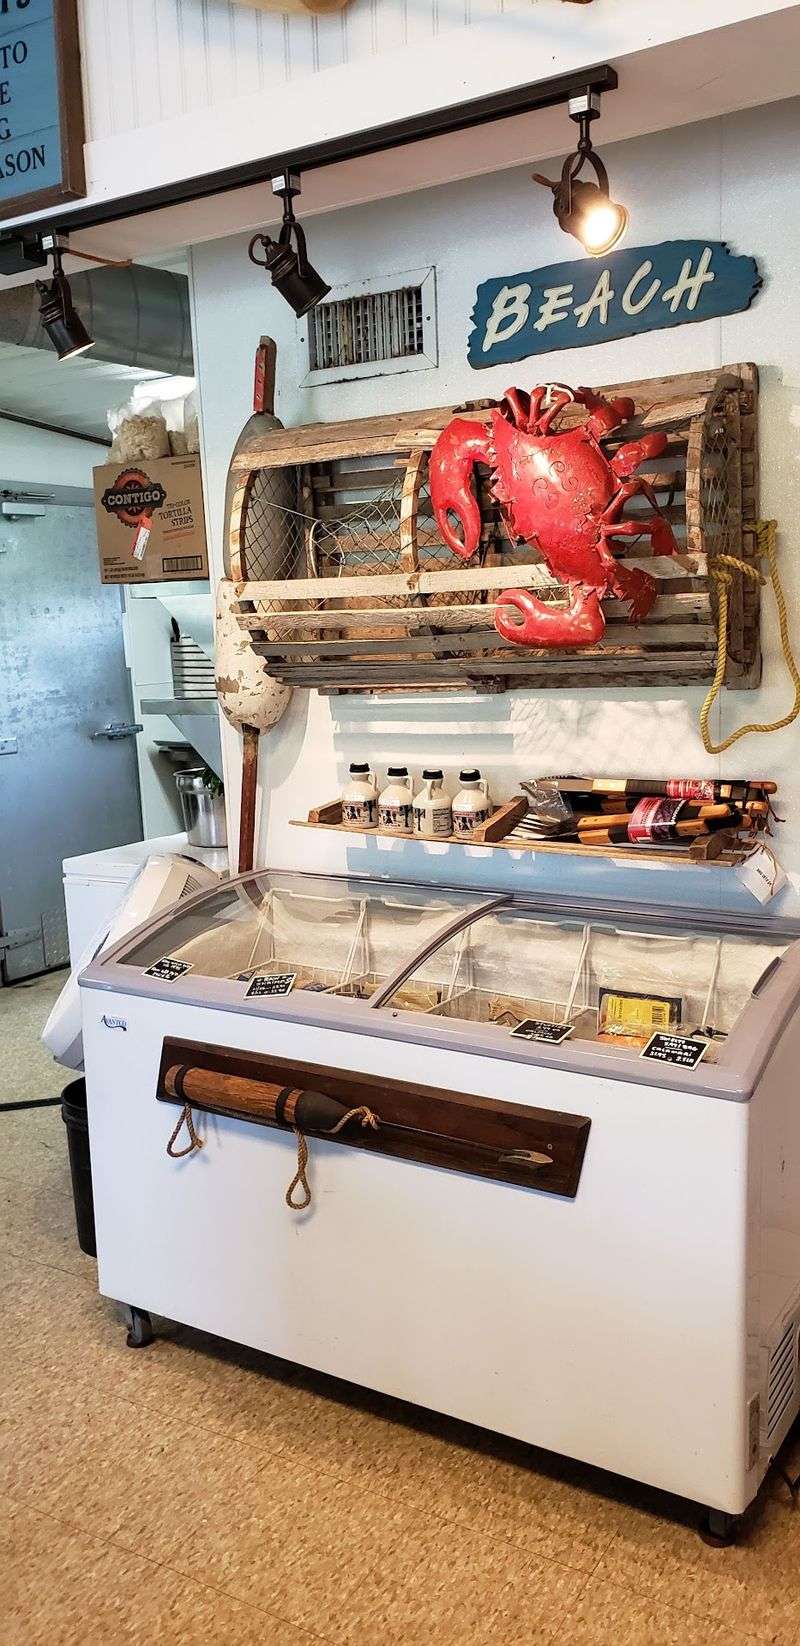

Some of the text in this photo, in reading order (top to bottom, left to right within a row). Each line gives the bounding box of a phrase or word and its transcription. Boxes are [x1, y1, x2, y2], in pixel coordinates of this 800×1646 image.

[482, 246, 715, 352] BEACH
[107, 490, 161, 506] CONTIGO
[158, 506, 193, 520] TORTILLA
[170, 515, 194, 527] STRIPS
